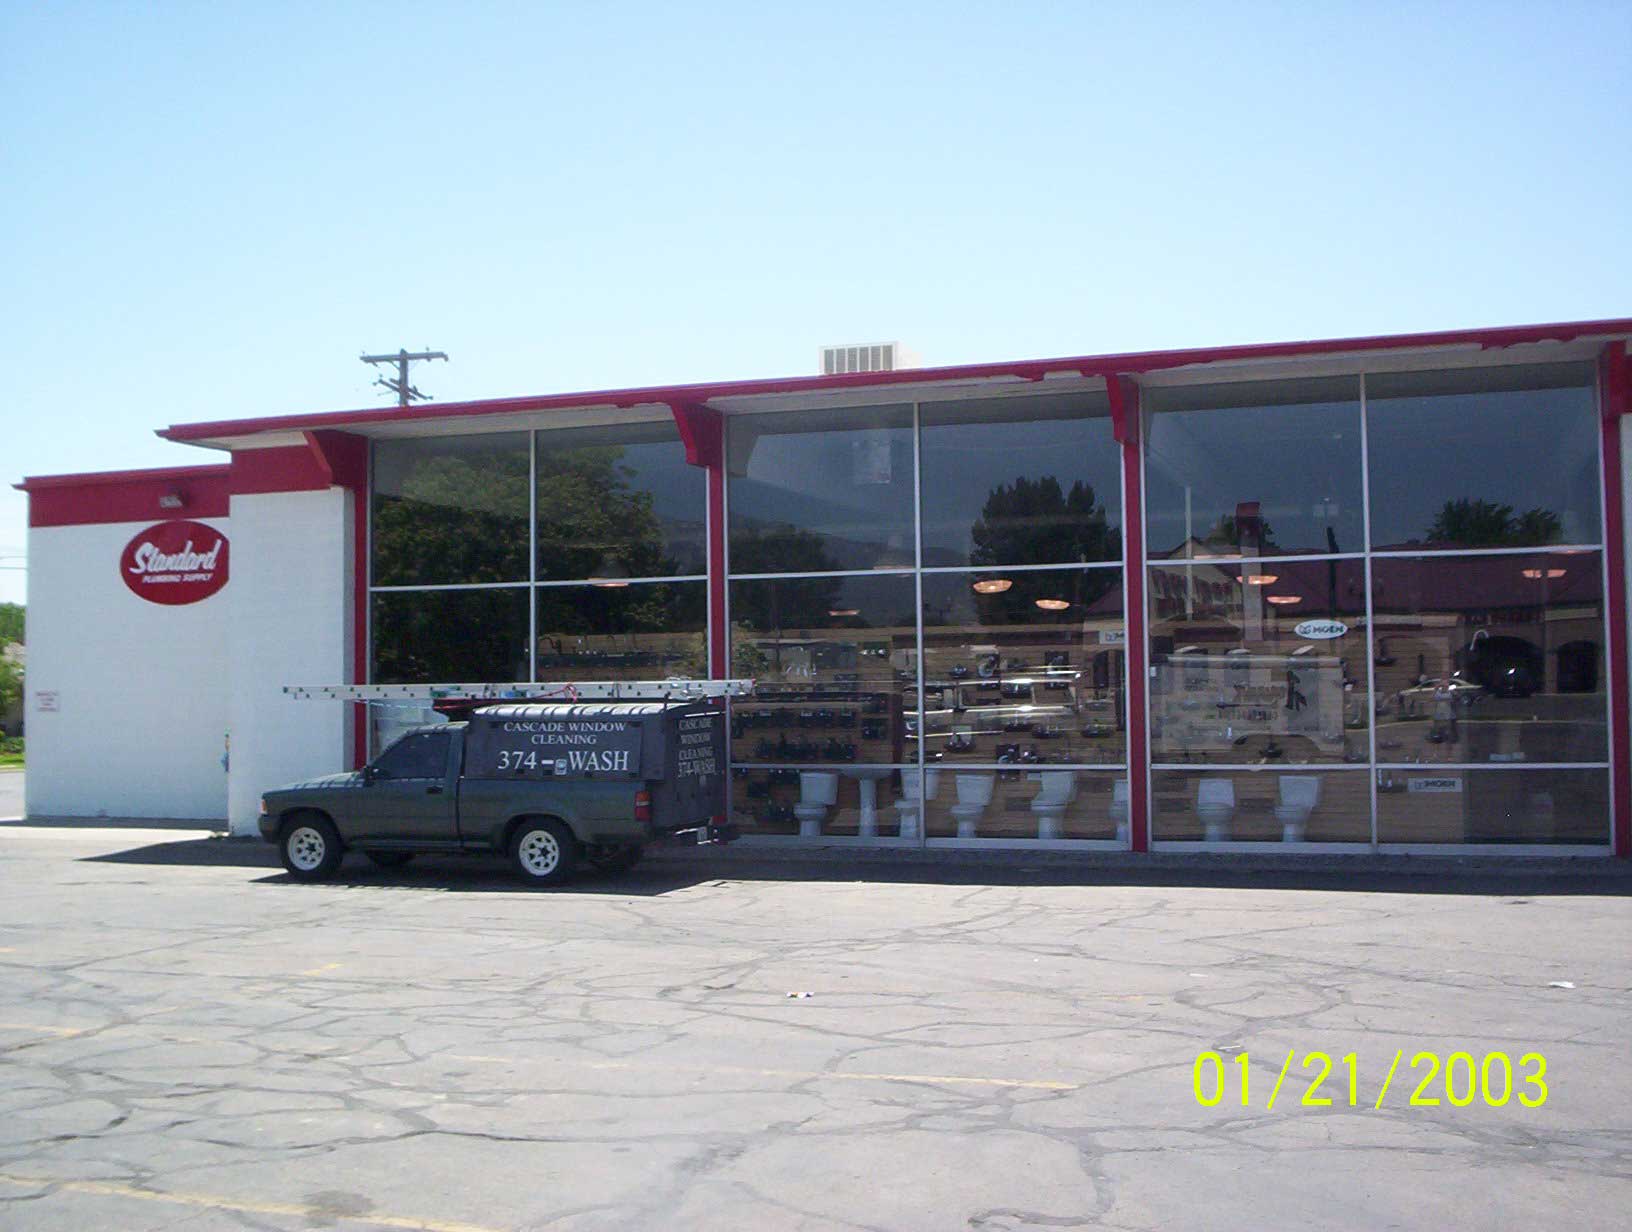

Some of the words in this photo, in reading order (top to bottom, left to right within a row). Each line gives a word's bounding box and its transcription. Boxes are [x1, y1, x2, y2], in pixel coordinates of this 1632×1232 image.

[128, 539, 222, 574] Standard
[182, 573, 213, 582] SUPPLY
[503, 721, 565, 732] CASCADE
[569, 721, 626, 732] WINDOW
[531, 734, 597, 745] CLEANING
[568, 750, 629, 771] WASH
